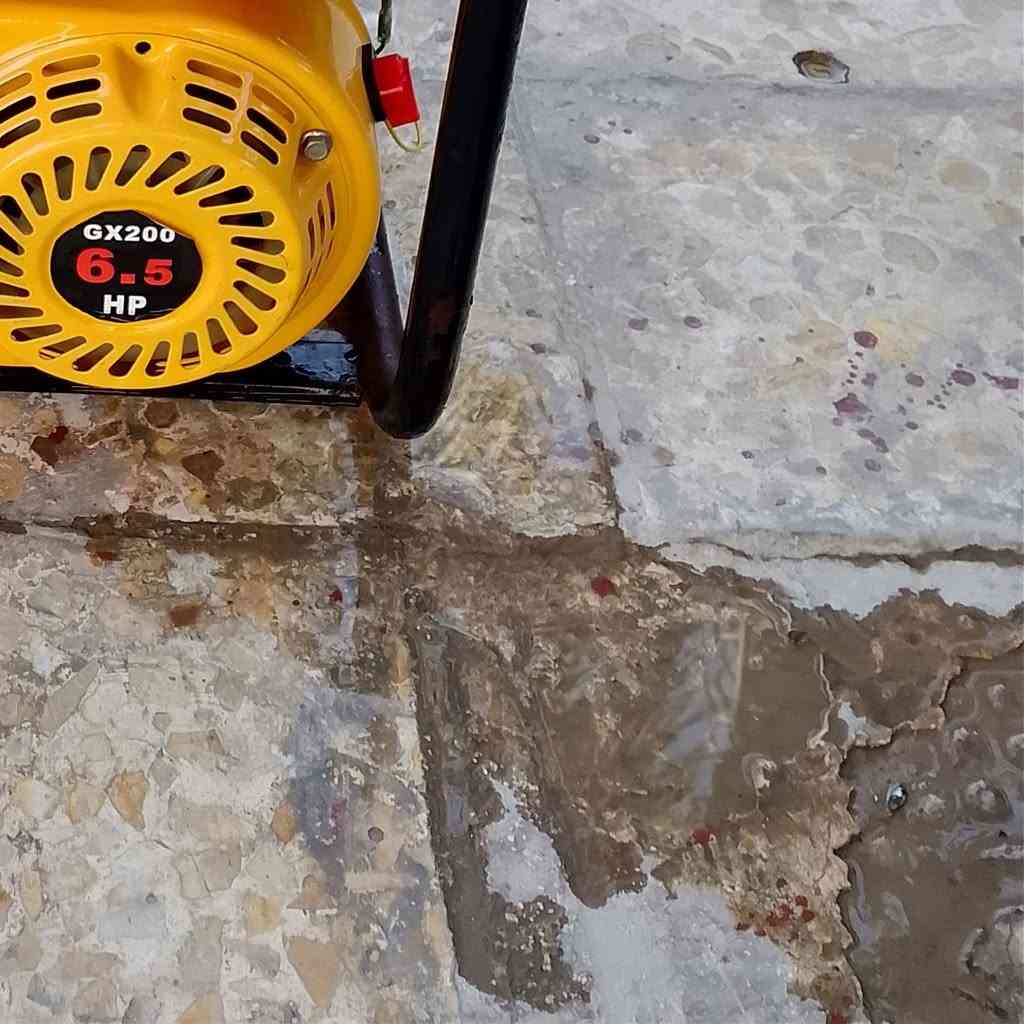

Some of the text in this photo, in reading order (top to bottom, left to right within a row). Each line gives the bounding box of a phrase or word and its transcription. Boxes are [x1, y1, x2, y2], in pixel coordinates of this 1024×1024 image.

[83, 223, 176, 243] GX200
[76, 247, 174, 286] 6.5
[102, 294, 147, 316] HP
